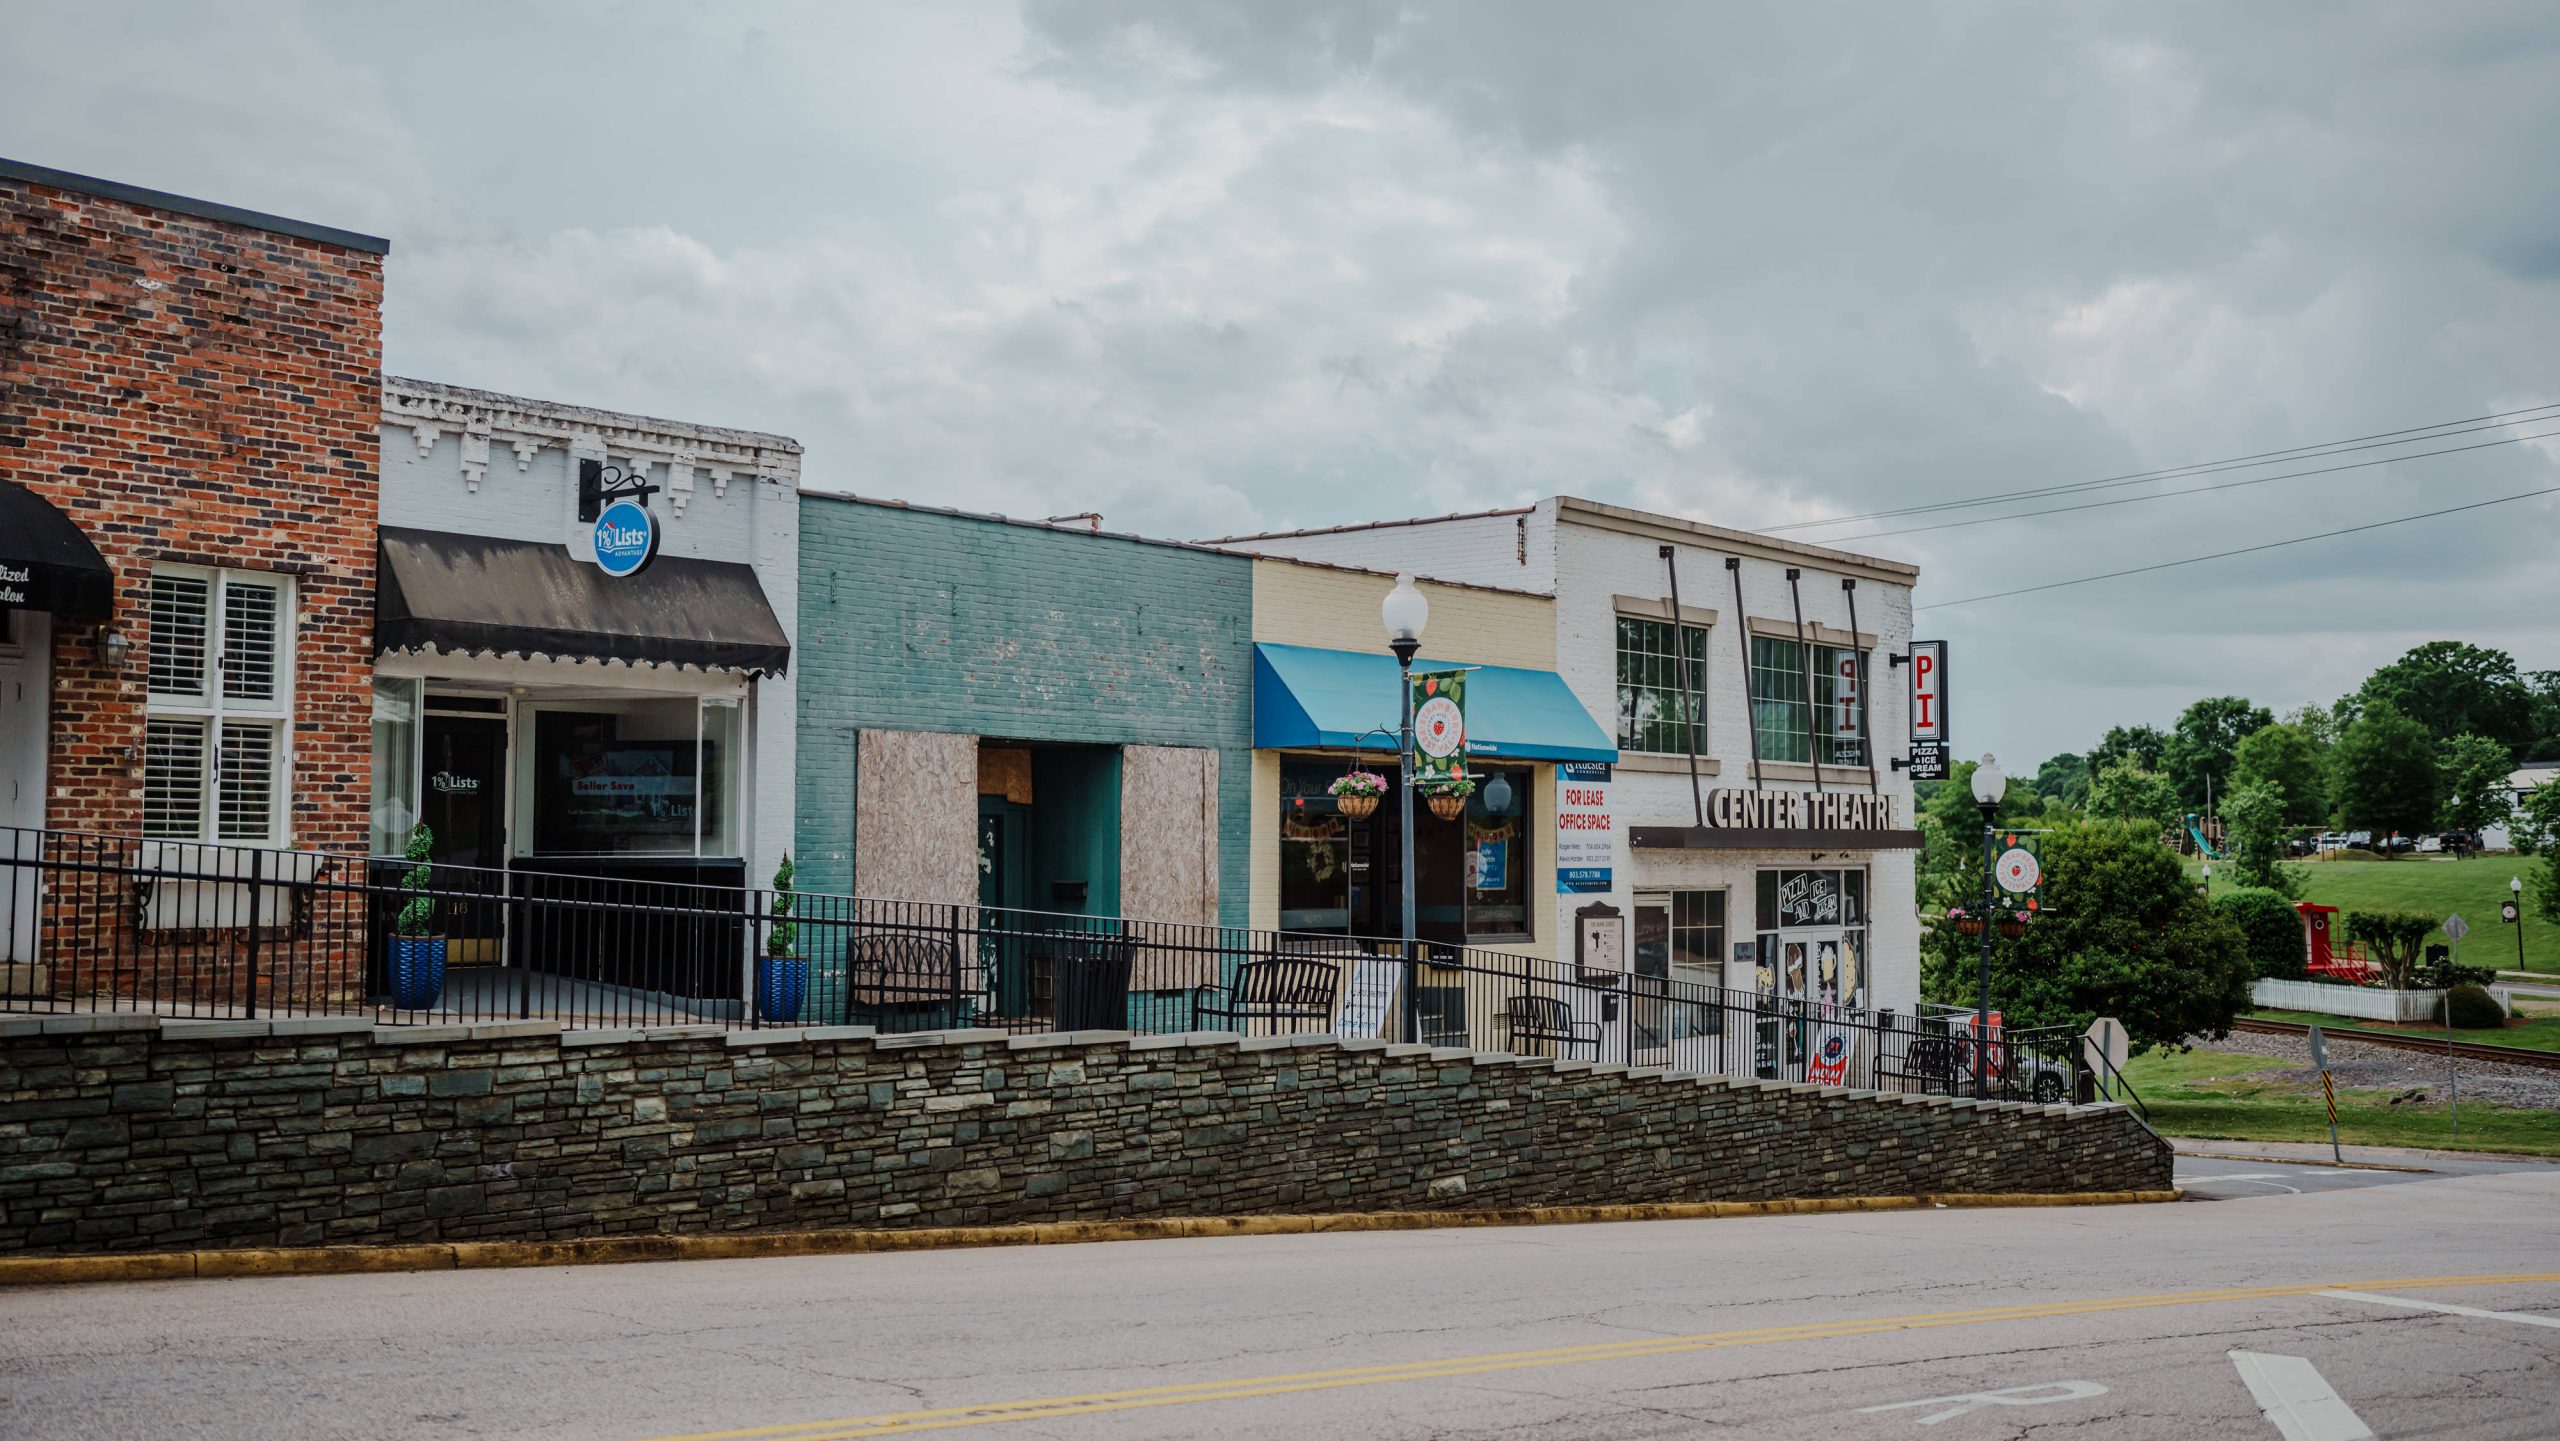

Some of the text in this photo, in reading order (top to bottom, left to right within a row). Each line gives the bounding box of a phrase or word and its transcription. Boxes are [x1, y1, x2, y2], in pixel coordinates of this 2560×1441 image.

[615, 527, 644, 546] Lists
[1471, 743, 1498, 752] Nationwide
[1912, 747, 1939, 756] PIZZA
[1910, 764, 1942, 772] CREAM
[1921, 756, 1937, 764] ICE
[450, 776, 478, 788] Lists
[1566, 789, 1604, 806] FOR LEASE
[671, 804, 697, 817] List
[1708, 788, 1900, 831] CENTER THEATRE
[1559, 813, 1611, 830] OFFICE SPACE
[1781, 876, 1807, 907] PIZZA
[1812, 881, 1824, 897] ICE
[1817, 896, 1837, 916] CREAM
